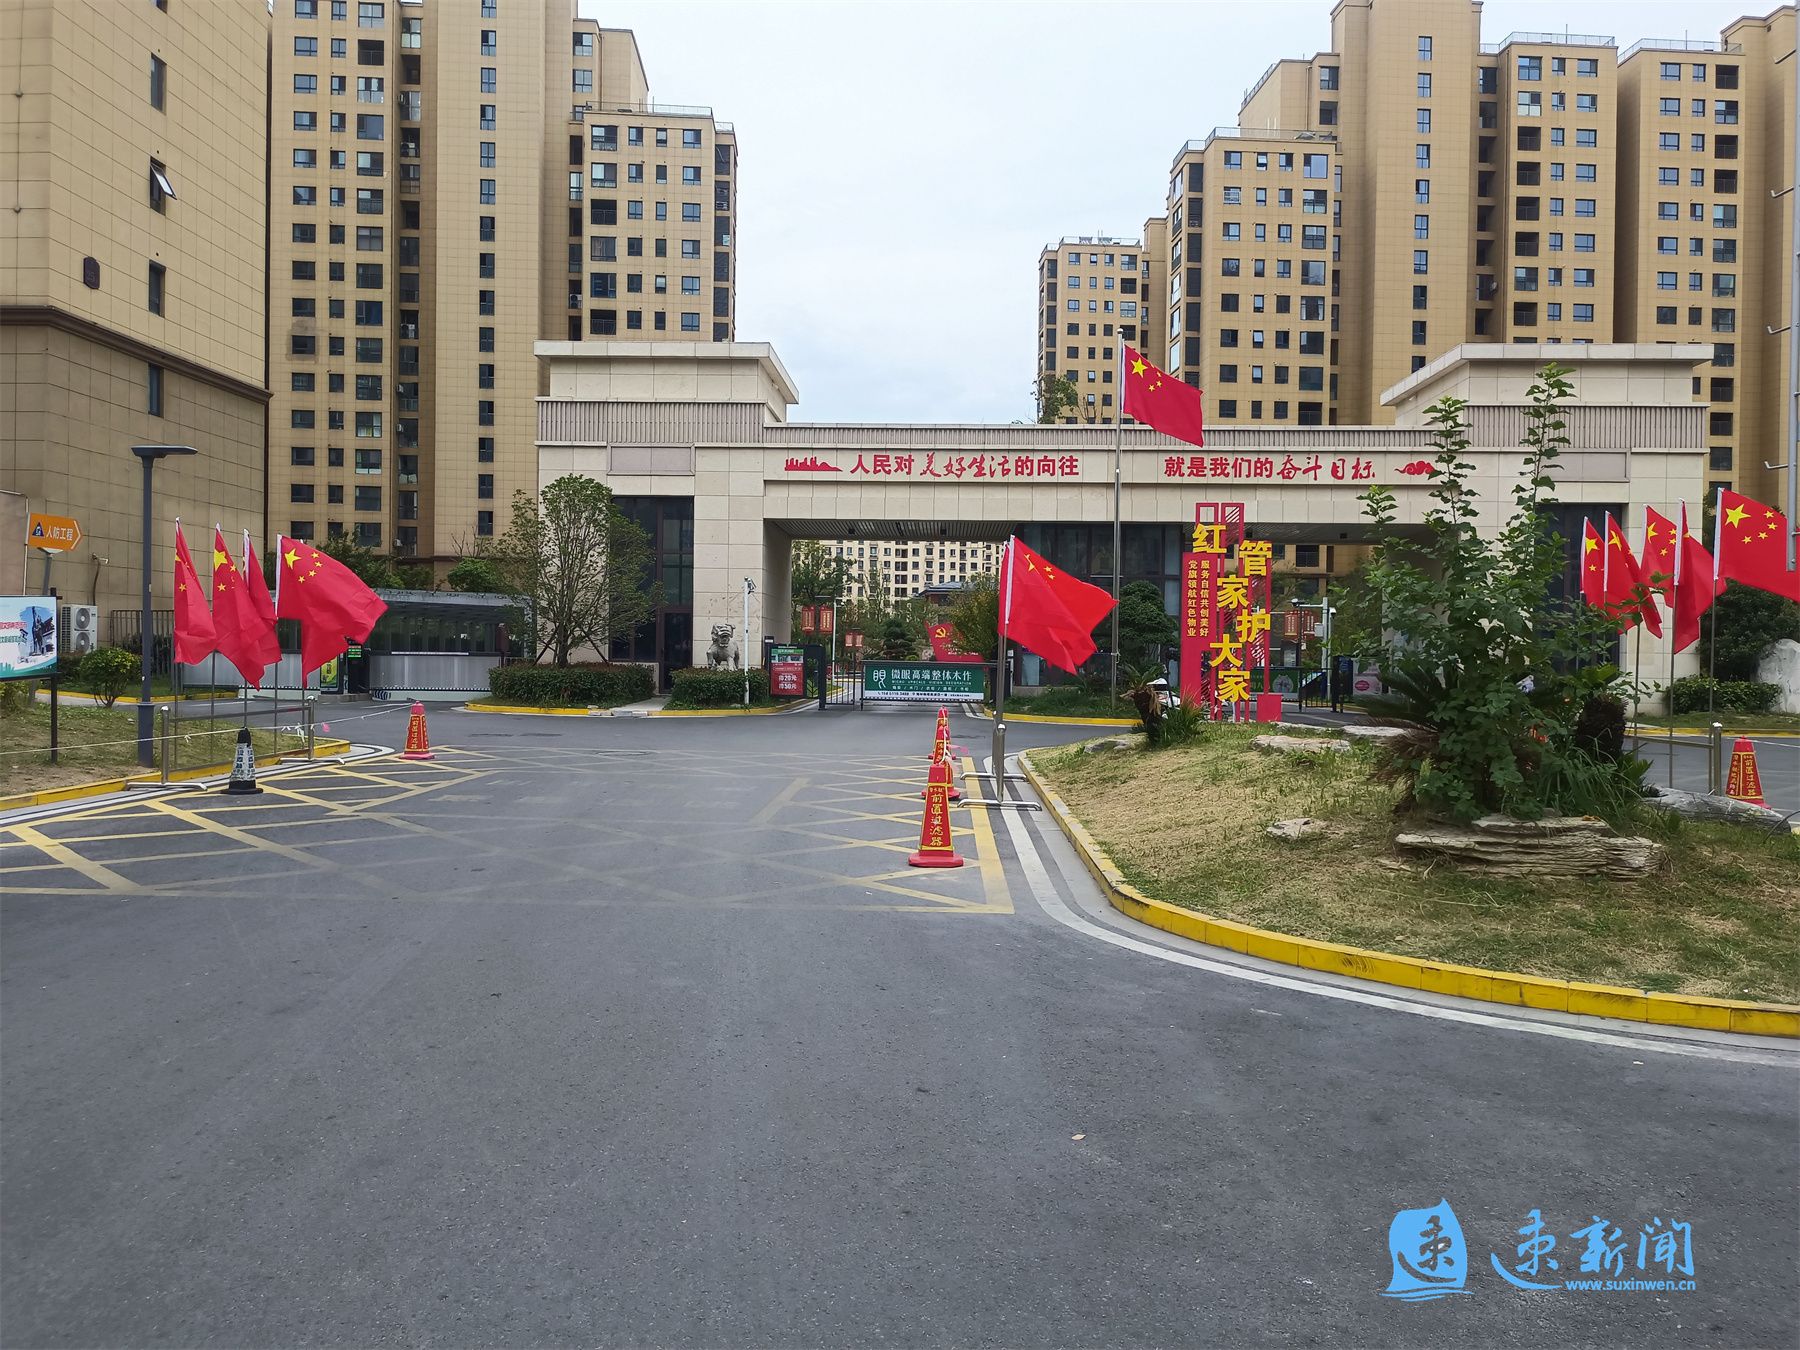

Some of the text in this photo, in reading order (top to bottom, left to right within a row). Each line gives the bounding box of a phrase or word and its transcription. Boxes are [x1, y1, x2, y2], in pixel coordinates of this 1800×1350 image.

[850, 452, 1079, 478] 人民对美好生活的向往
[1164, 455, 1376, 481] 就是我们的奋斗目标
[46, 525, 74, 541] 人防工程
[1187, 559, 1198, 637] 党旗领航红色物业
[1199, 559, 1210, 637] 服务自信共创美好
[891, 669, 972, 681] 微眼高端整体木作
[929, 793, 944, 847] 前置过滤器
